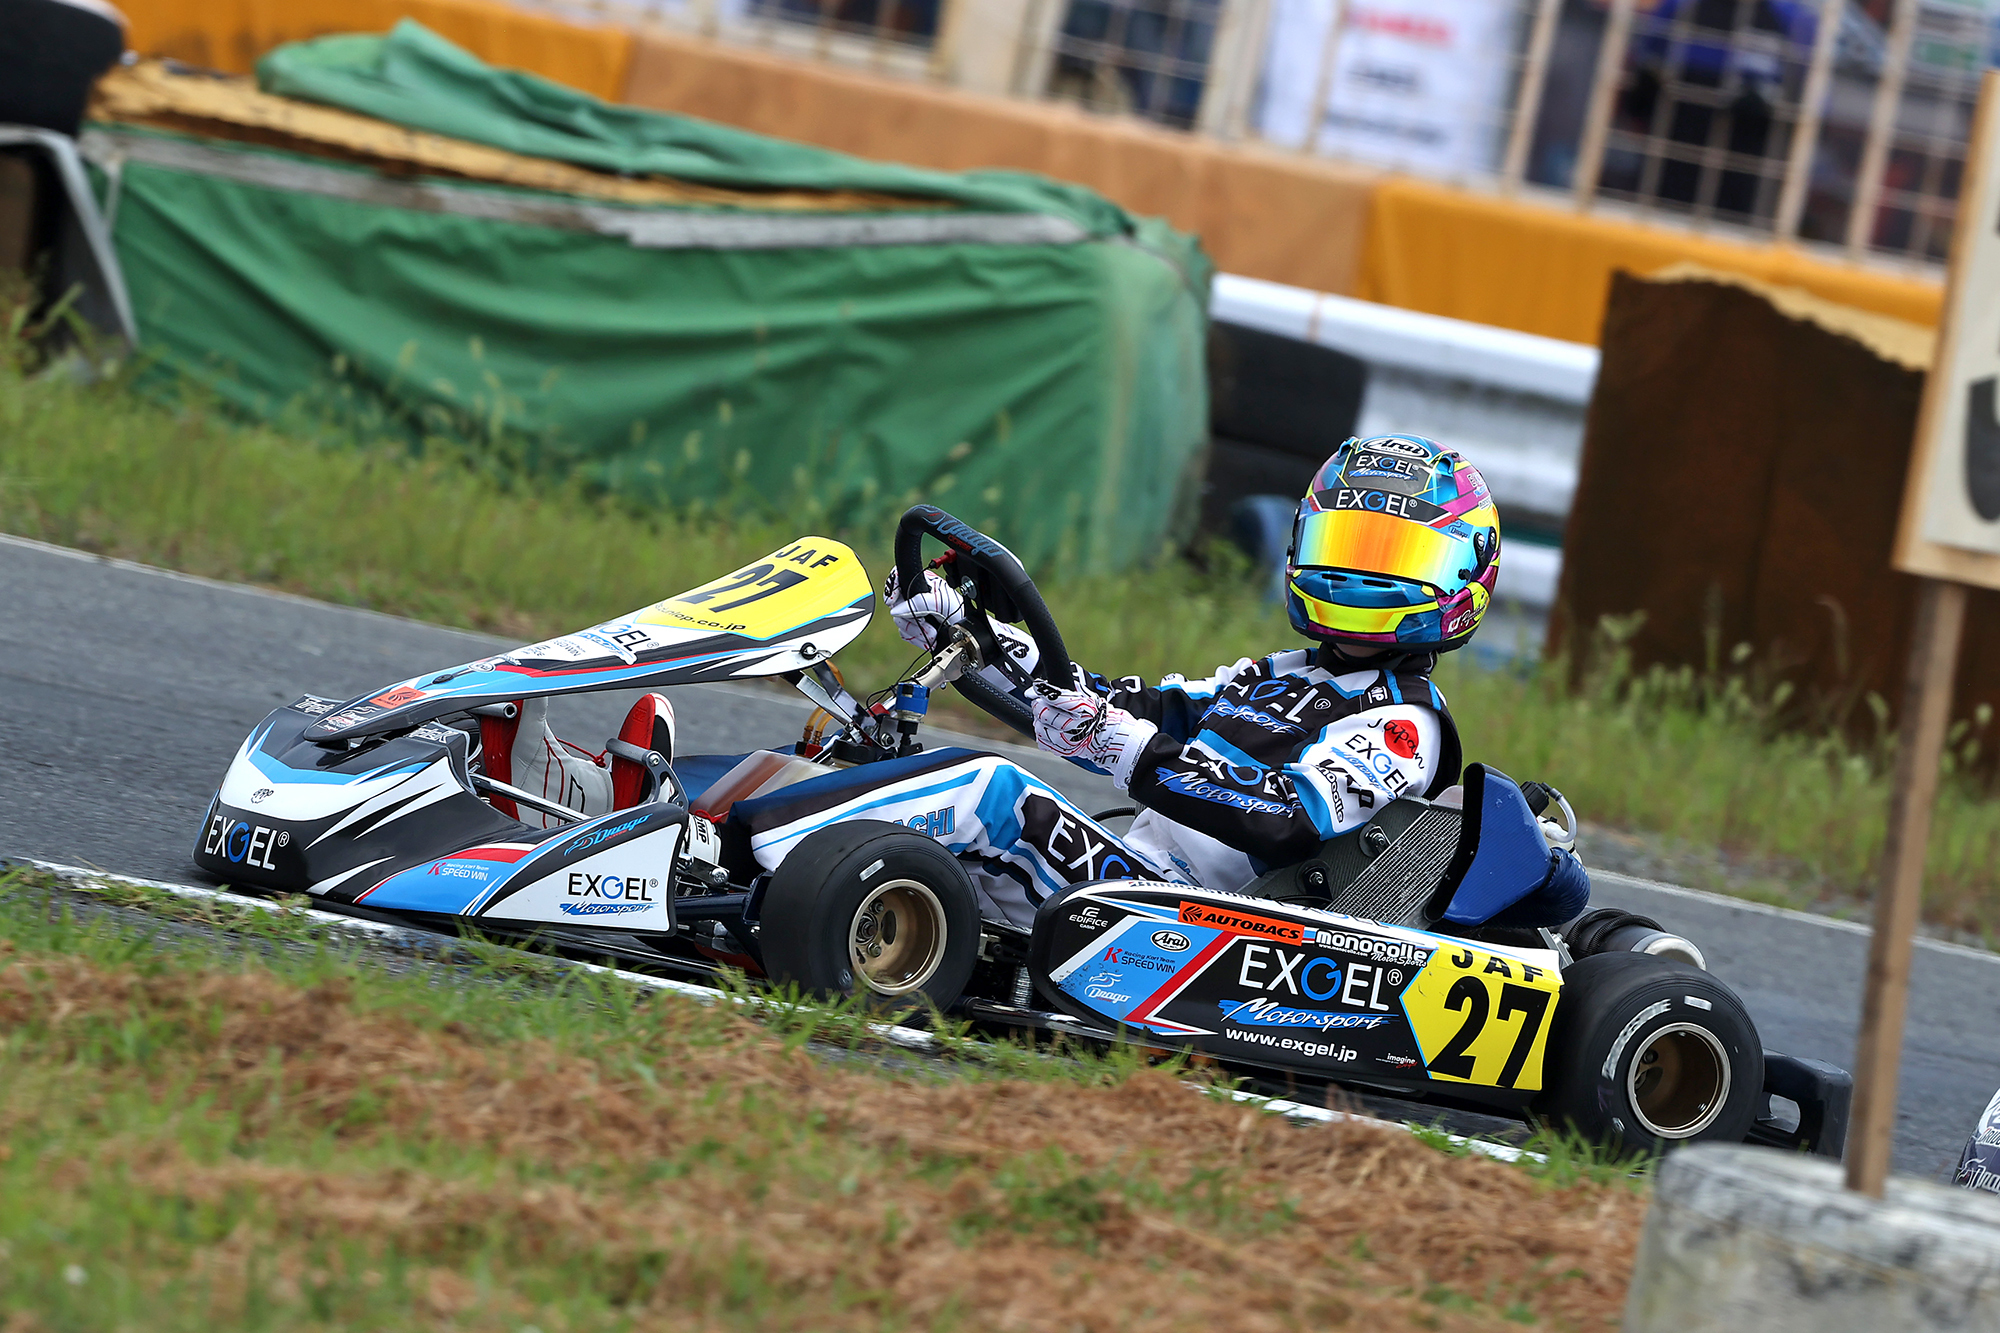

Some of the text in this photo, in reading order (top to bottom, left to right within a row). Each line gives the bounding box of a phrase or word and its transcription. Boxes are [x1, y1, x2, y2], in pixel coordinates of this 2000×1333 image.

[775, 545, 839, 569] JAF
[675, 563, 809, 613] 27
[1367, 718, 1425, 770] Japan
[441, 867, 489, 881] SPEED WIN
[563, 902, 652, 916] Motorsport
[1068, 914, 1109, 928] EDIFICE
[1202, 912, 1301, 940] AUTOBACS
[1153, 931, 1186, 948] Arai
[1316, 930, 1428, 962] monocolle
[1121, 956, 1176, 973] SPEED WIN
[1124, 951, 1145, 960] Racing
[1451, 949, 1543, 983] JAF
[1087, 987, 1132, 1004] Drago
[1220, 997, 1383, 1033] Motorsport
[1225, 1028, 1358, 1062] www.exgel.jp
[1427, 975, 1552, 1089] 27
